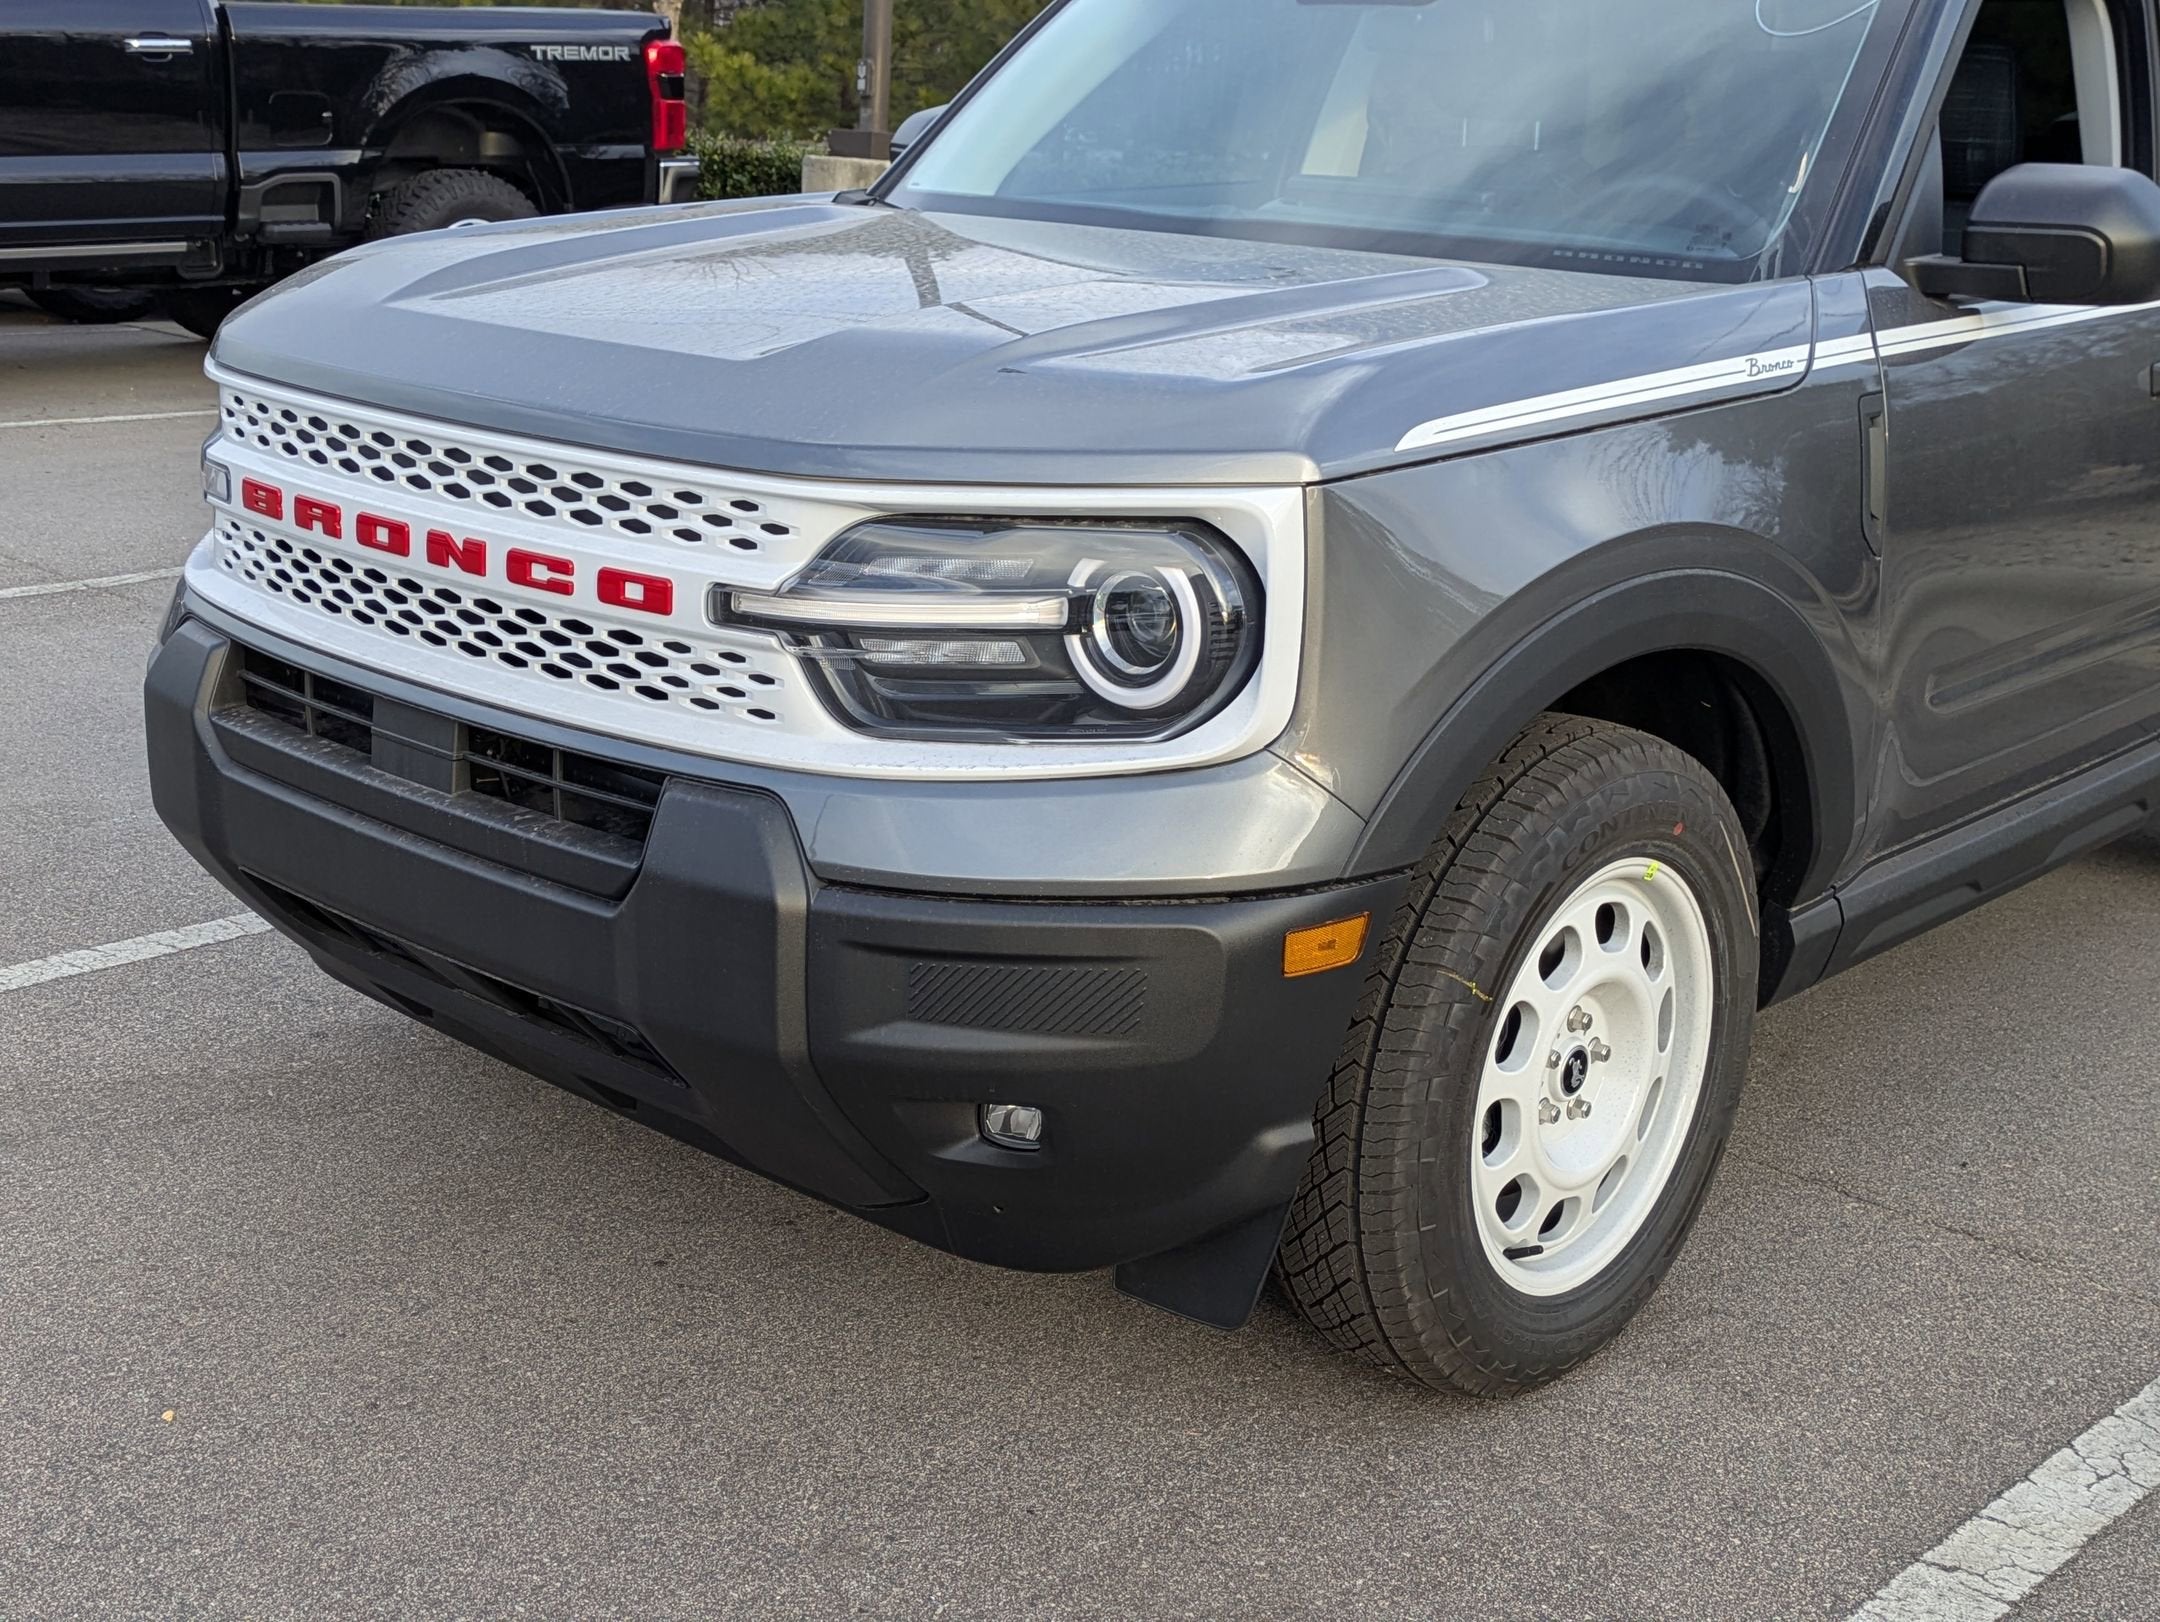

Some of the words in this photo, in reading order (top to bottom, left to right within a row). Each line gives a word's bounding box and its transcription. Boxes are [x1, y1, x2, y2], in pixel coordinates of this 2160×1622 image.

[530, 45, 631, 61] TREMOR
[1745, 358, 1794, 377] Bronco
[242, 475, 674, 617] BRONCO
